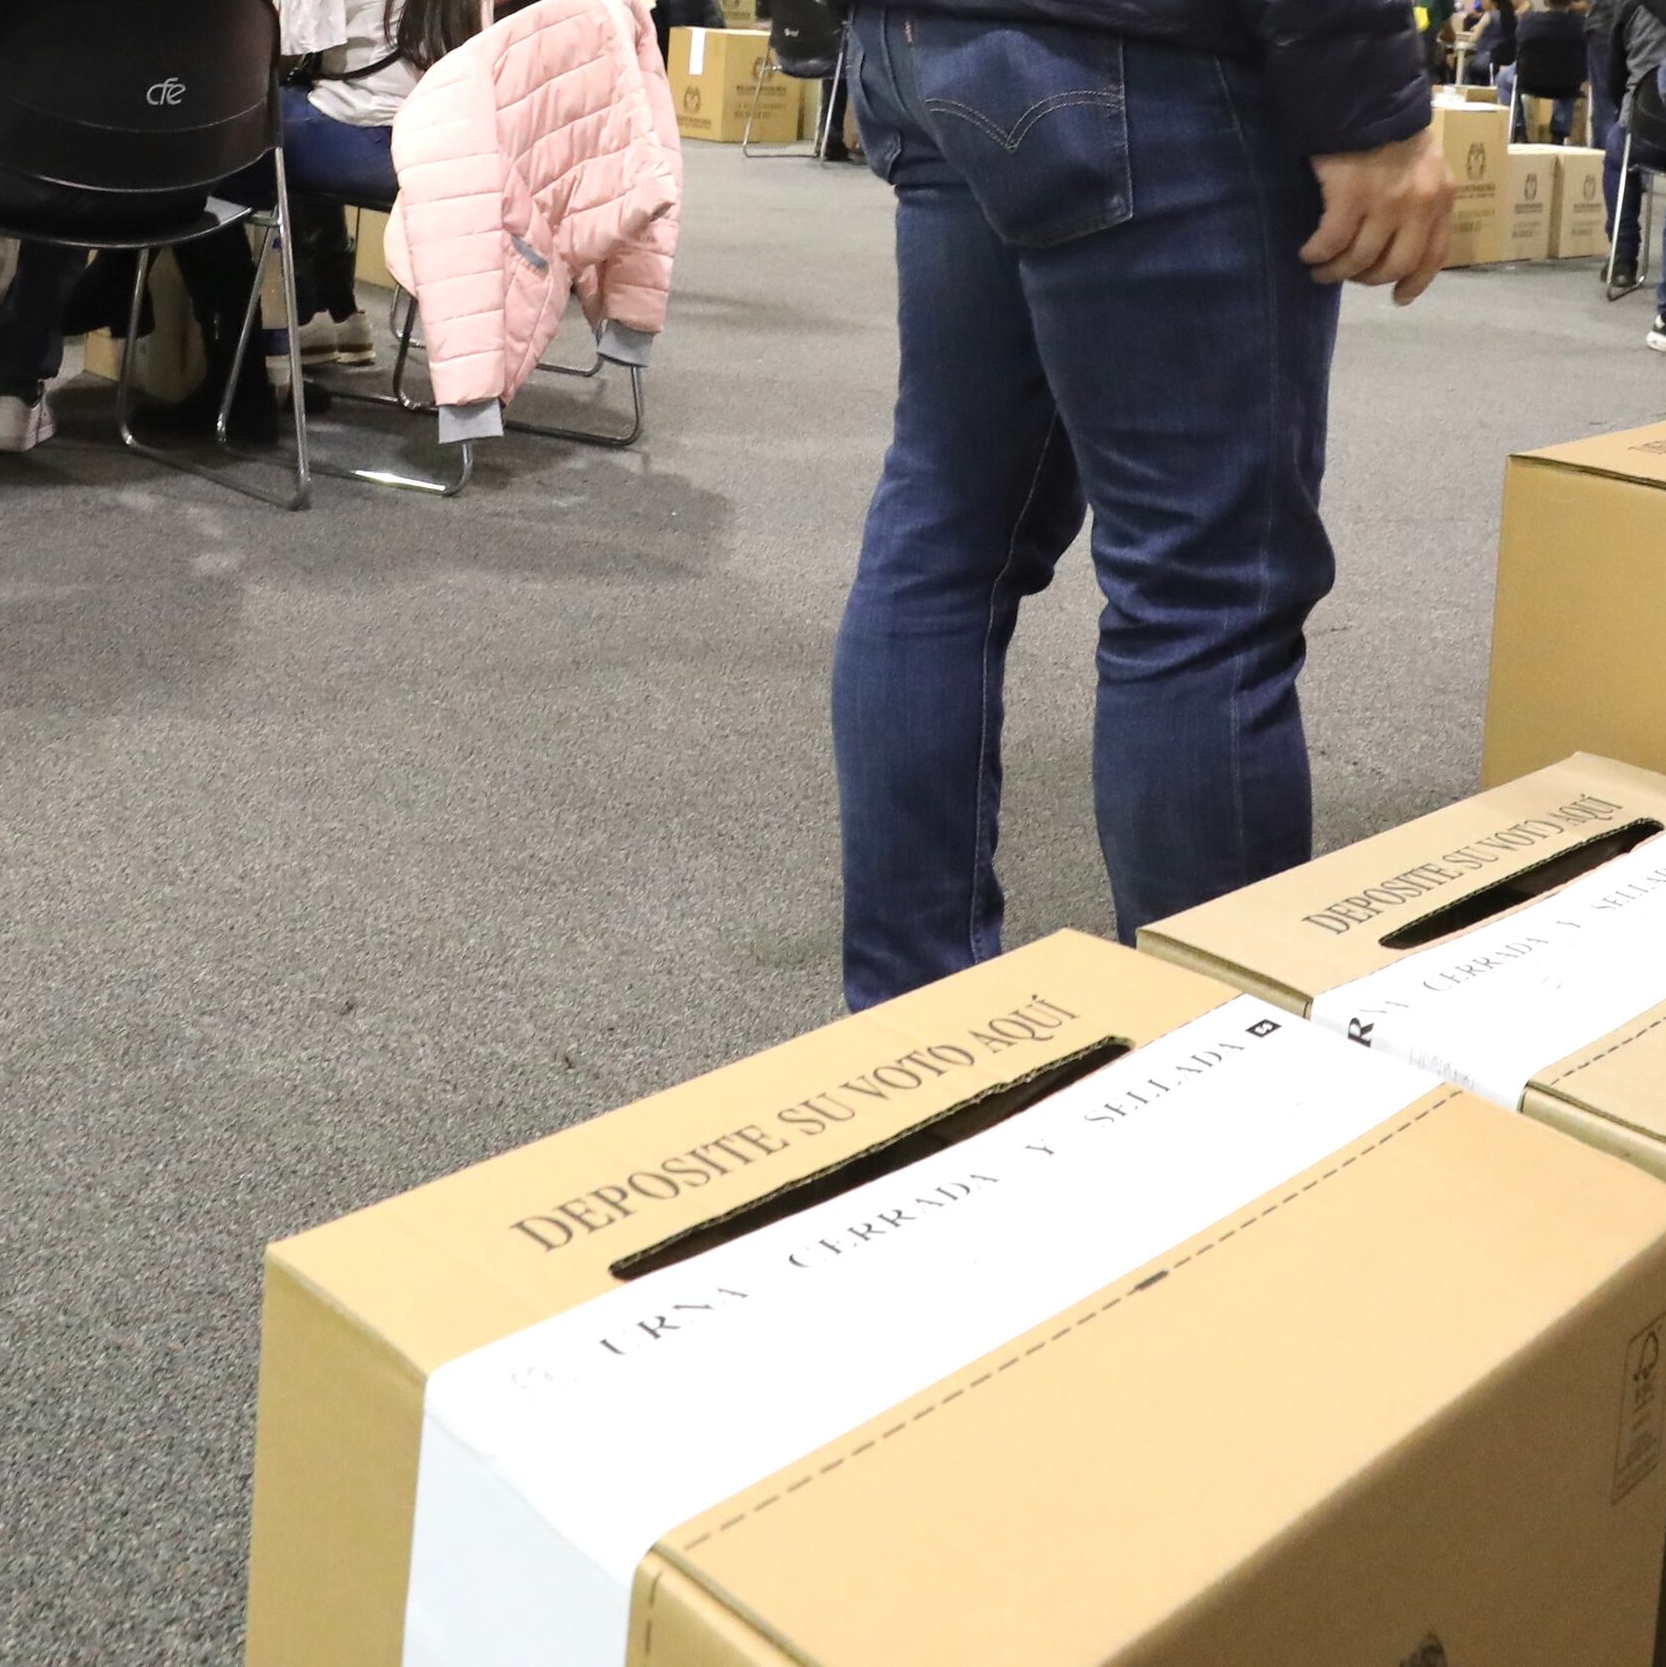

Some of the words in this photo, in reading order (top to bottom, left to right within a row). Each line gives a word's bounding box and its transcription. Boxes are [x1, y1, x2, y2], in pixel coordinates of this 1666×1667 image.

[1301, 862, 1464, 935] DEPOSITE
[1442, 838, 1499, 870] SU
[1549, 793, 1623, 827] AQUÍ
[509, 1123, 788, 1252] DEPOSITE
[777, 1093, 857, 1136] SU
[839, 1043, 976, 1102] VOTO
[969, 994, 1081, 1055] AQUÍ
[787, 1171, 999, 1269] CERRADA
[1025, 1142, 1056, 1160] Y
[1084, 1041, 1246, 1127] SELLADA
